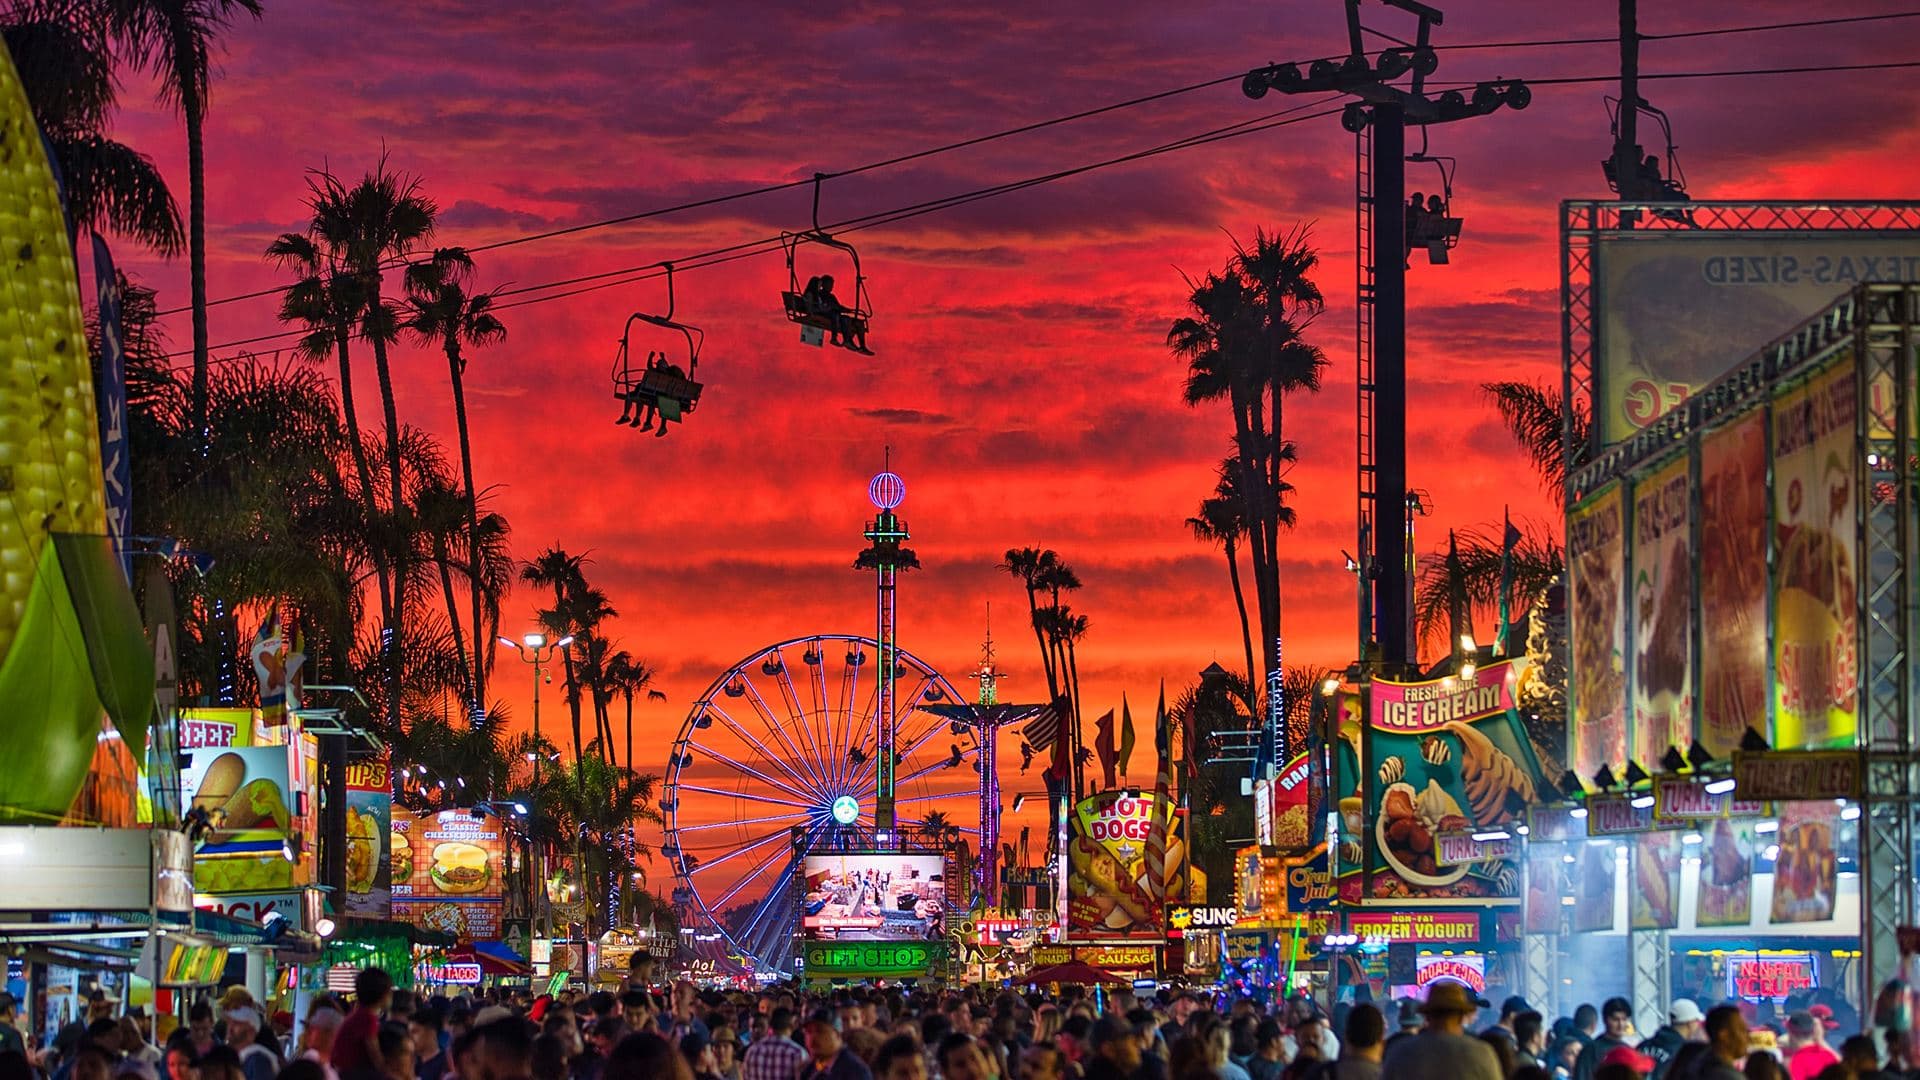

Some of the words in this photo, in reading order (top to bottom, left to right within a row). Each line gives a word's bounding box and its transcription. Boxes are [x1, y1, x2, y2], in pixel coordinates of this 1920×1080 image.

[1383, 700, 1418, 726] ICE
[1422, 684, 1500, 725] CREAM
[1818, 759, 1851, 792] LEG
[1660, 782, 1722, 814] TURKEY
[1099, 799, 1153, 818] HOT
[424, 831, 498, 840] CHEESEBURGER
[442, 824, 481, 832] CLASSIC
[1091, 820, 1151, 840] DOGS
[1440, 838, 1486, 860] TURKEY
[1354, 923, 1411, 939] FROZEN
[1415, 923, 1475, 938] YOGURT
[809, 949, 858, 966] GIFT
[864, 949, 926, 966] SHOP
[447, 967, 478, 979] TACOS
